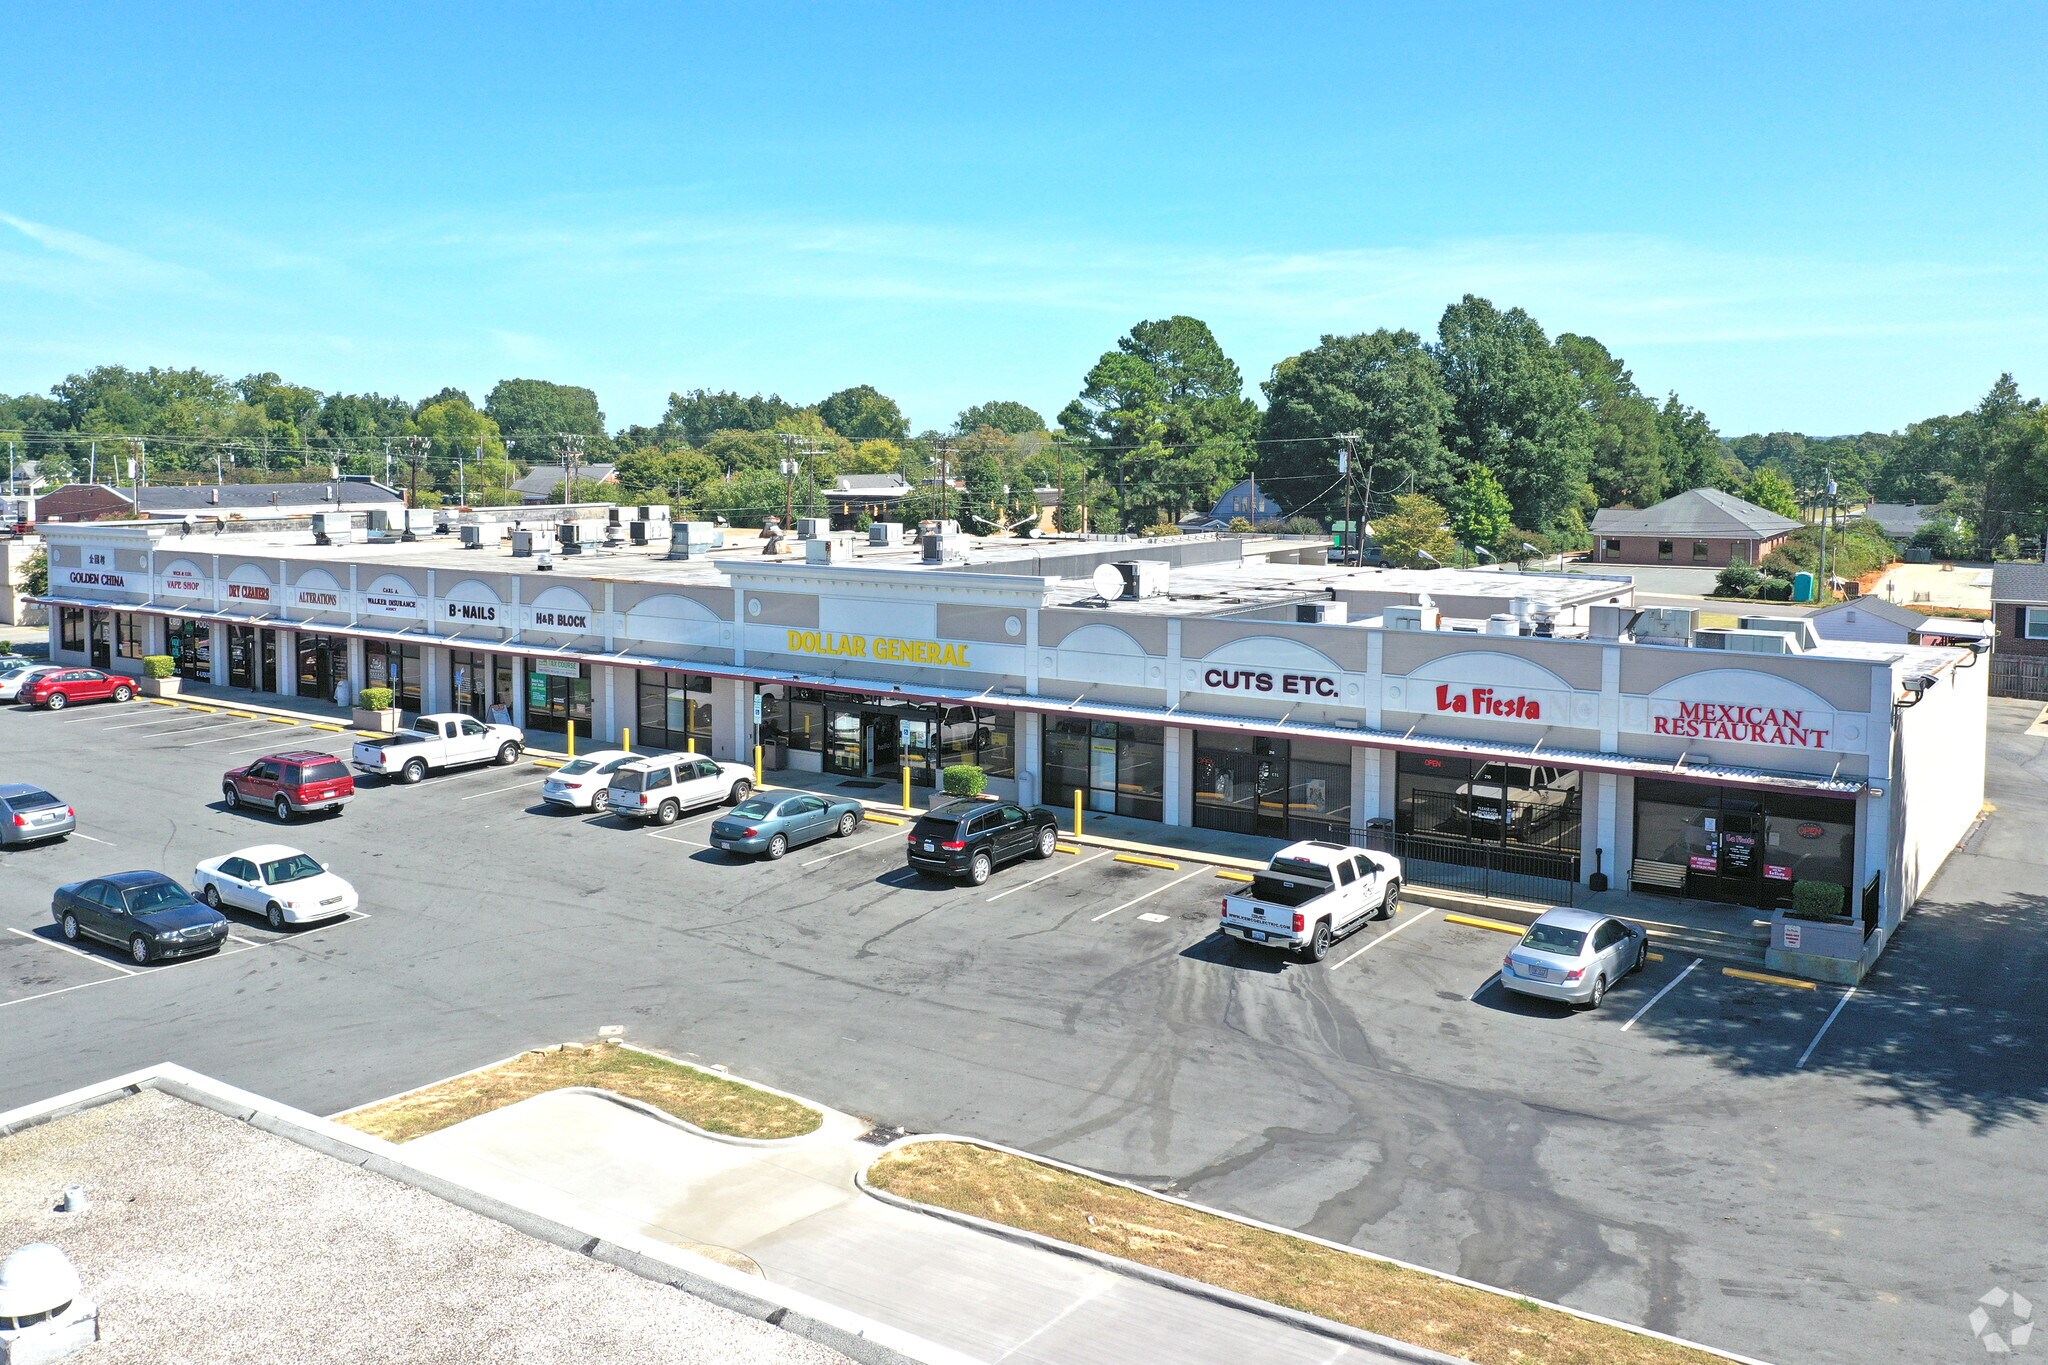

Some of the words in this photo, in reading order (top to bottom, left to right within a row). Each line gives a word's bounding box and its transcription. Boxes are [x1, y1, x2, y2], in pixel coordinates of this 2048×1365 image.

[69, 571, 100, 585] GOLDEN
[100, 574, 125, 587] CHINA
[167, 580, 182, 590] VAPE
[183, 581, 200, 591] SHOP
[228, 584, 241, 598] DRY
[241, 585, 270, 601] CLEANERS
[298, 591, 337, 606] ALTERATIONS
[367, 597, 387, 606] WALKER
[388, 599, 416, 609] INSURANCE
[535, 612, 554, 626] H&R
[557, 614, 587, 629] BLOCK
[787, 630, 867, 658] DOLLAR
[872, 637, 971, 668] GENERAL
[1204, 669, 1274, 692] CUTS
[1281, 675, 1340, 699] ETC.
[1435, 684, 1468, 714] La
[1472, 688, 1541, 720] Fiesta
[1678, 701, 1803, 729] MEXICAN
[1653, 716, 1830, 749] RESTAURANT
[1424, 759, 1442, 767] OPEN
[1798, 826, 1822, 835] OPEN
